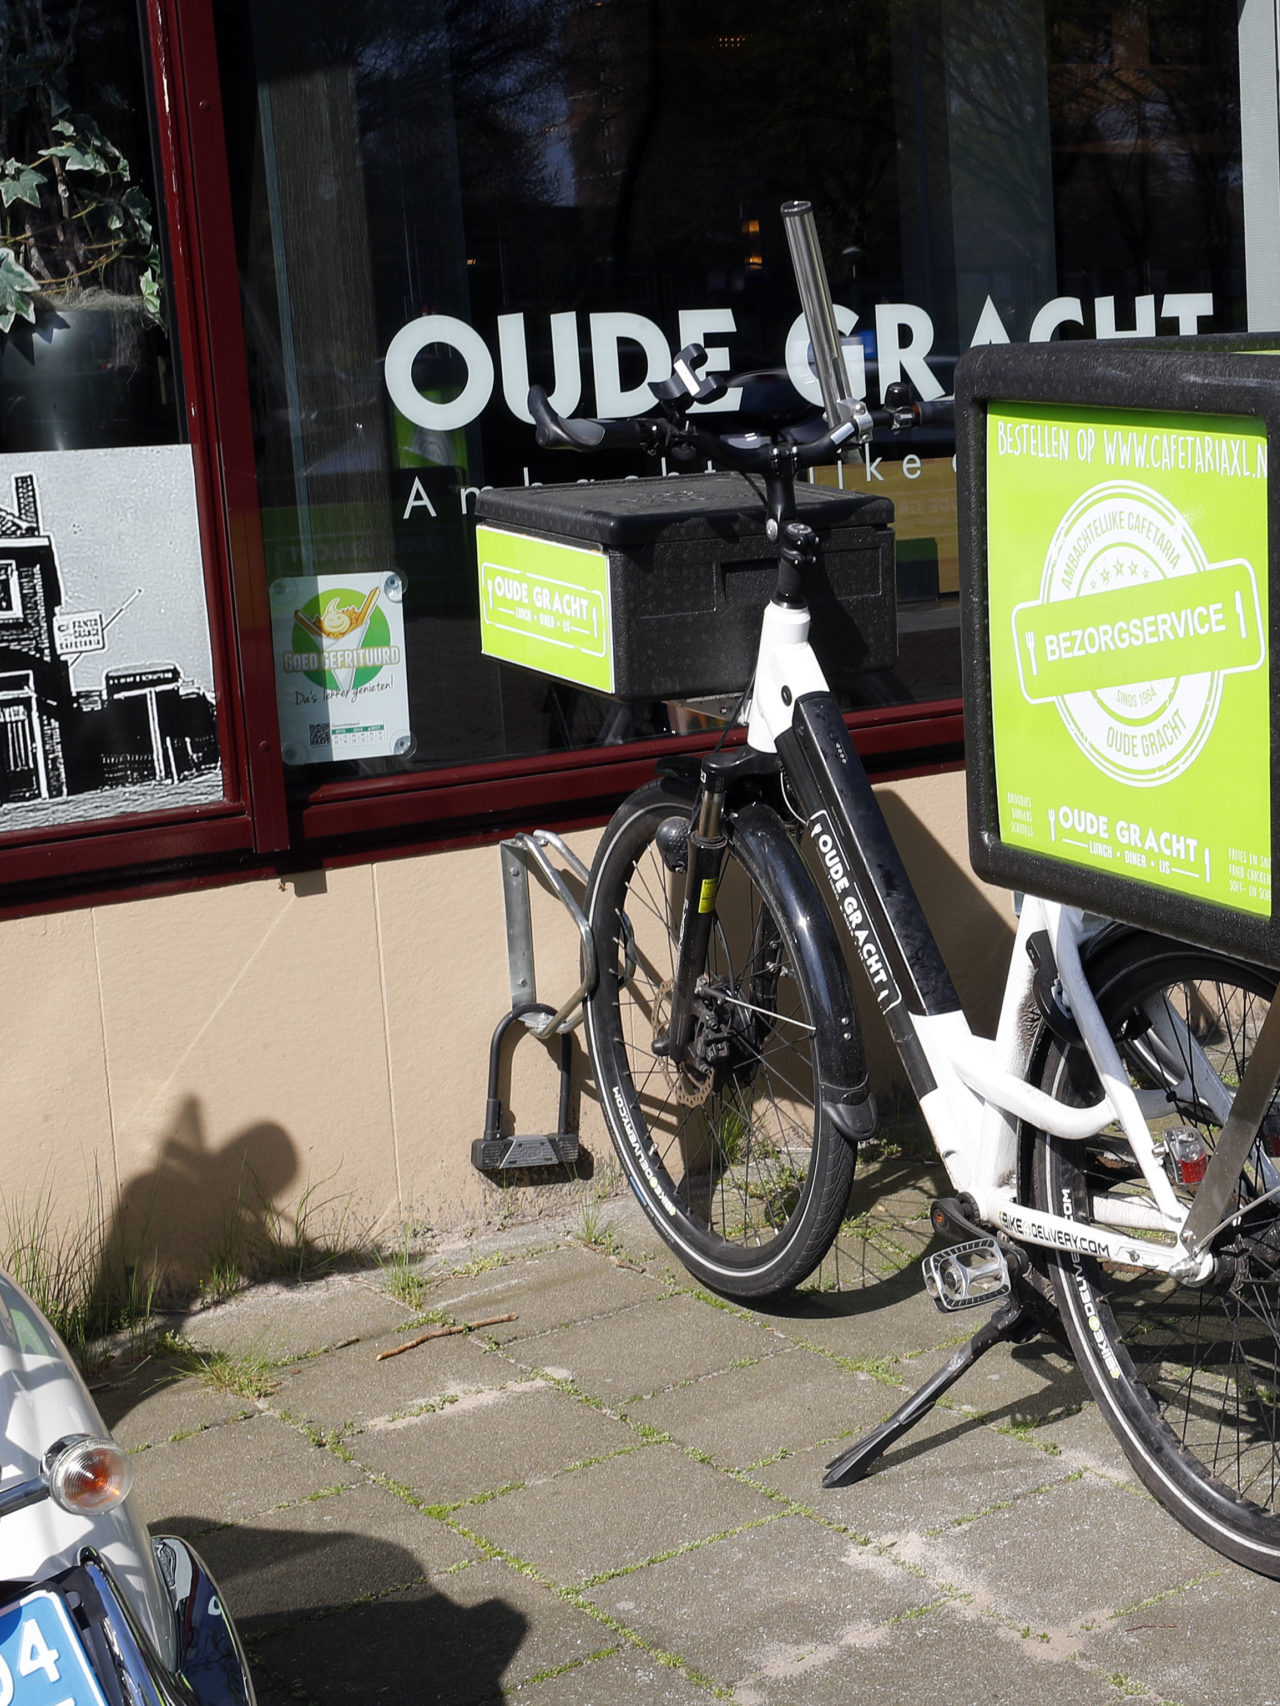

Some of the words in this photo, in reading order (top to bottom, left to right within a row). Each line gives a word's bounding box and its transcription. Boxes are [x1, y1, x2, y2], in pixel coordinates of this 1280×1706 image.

[385, 308, 743, 431] OUDE
[998, 420, 1070, 461] BESTELLEN
[1076, 428, 1096, 464] OP
[1061, 510, 1125, 591] AMBACHTELIJKE
[1127, 511, 1181, 570] CAFETARIA
[494, 575, 529, 605] OUDE
[533, 585, 589, 621] GRACHT
[1044, 602, 1226, 662] BEZORGSERVICE
[283, 650, 318, 674] GOED
[321, 646, 400, 671] GEFRITUURD
[1116, 689, 1137, 708] SINDS
[1106, 725, 1138, 758] OUDE
[1140, 708, 1187, 758] GRACHT
[1058, 805, 1109, 839] OUDE
[1115, 820, 1198, 862] GRACHT
[1089, 840, 1113, 859] LUNCH
[1124, 849, 1147, 869] DINER
[818, 834, 850, 894] OUDE
[843, 896, 888, 984] GRACHT
